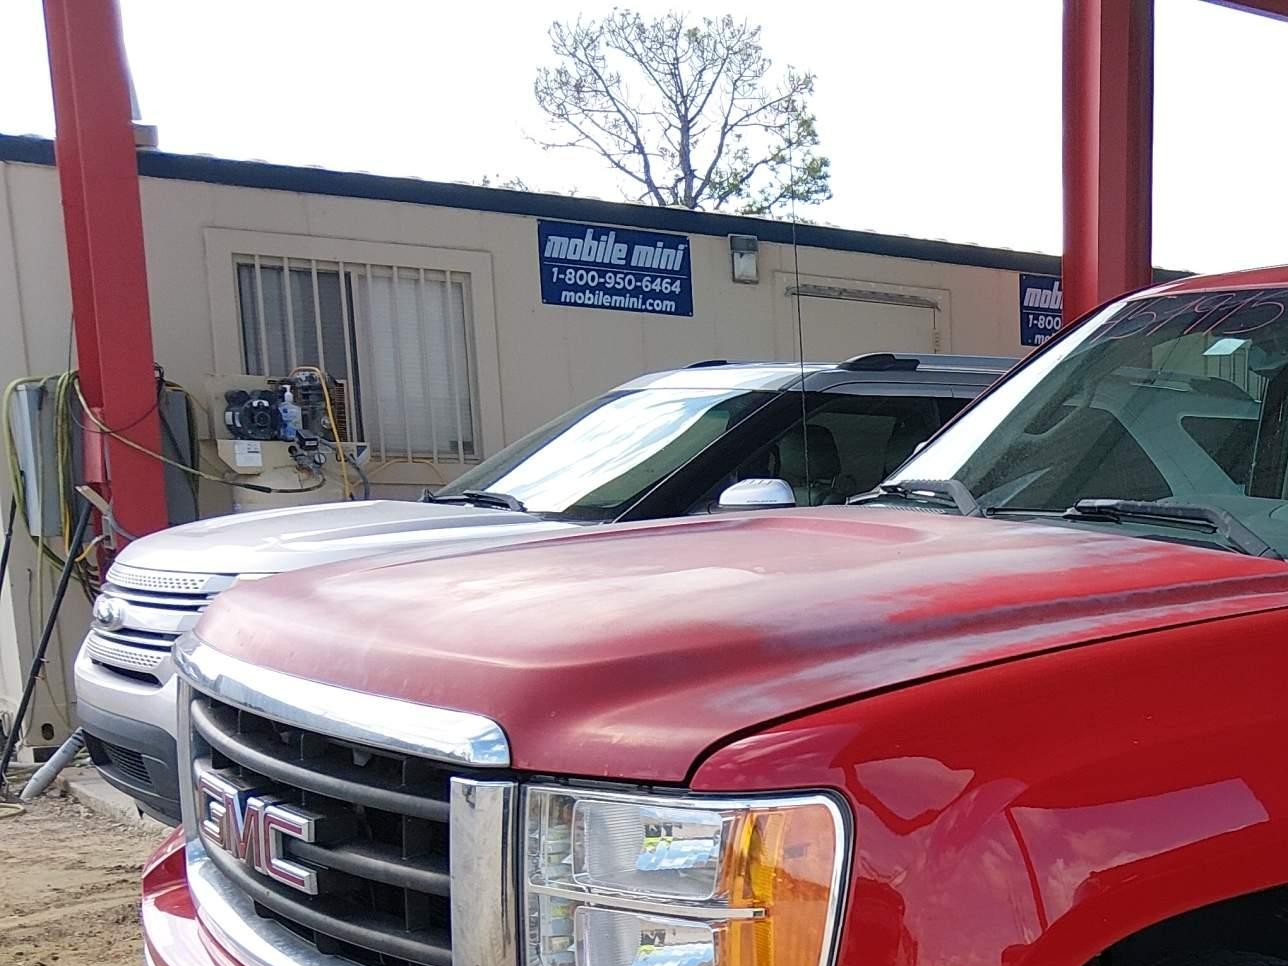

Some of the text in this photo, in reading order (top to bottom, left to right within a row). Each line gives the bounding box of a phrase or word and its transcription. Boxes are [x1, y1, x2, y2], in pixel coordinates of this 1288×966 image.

[544, 228, 684, 271] mobile mini
[551, 267, 681, 294] 1-800-950-6464
[560, 289, 676, 312] mobilemini.com
[199, 770, 318, 895] GMC
